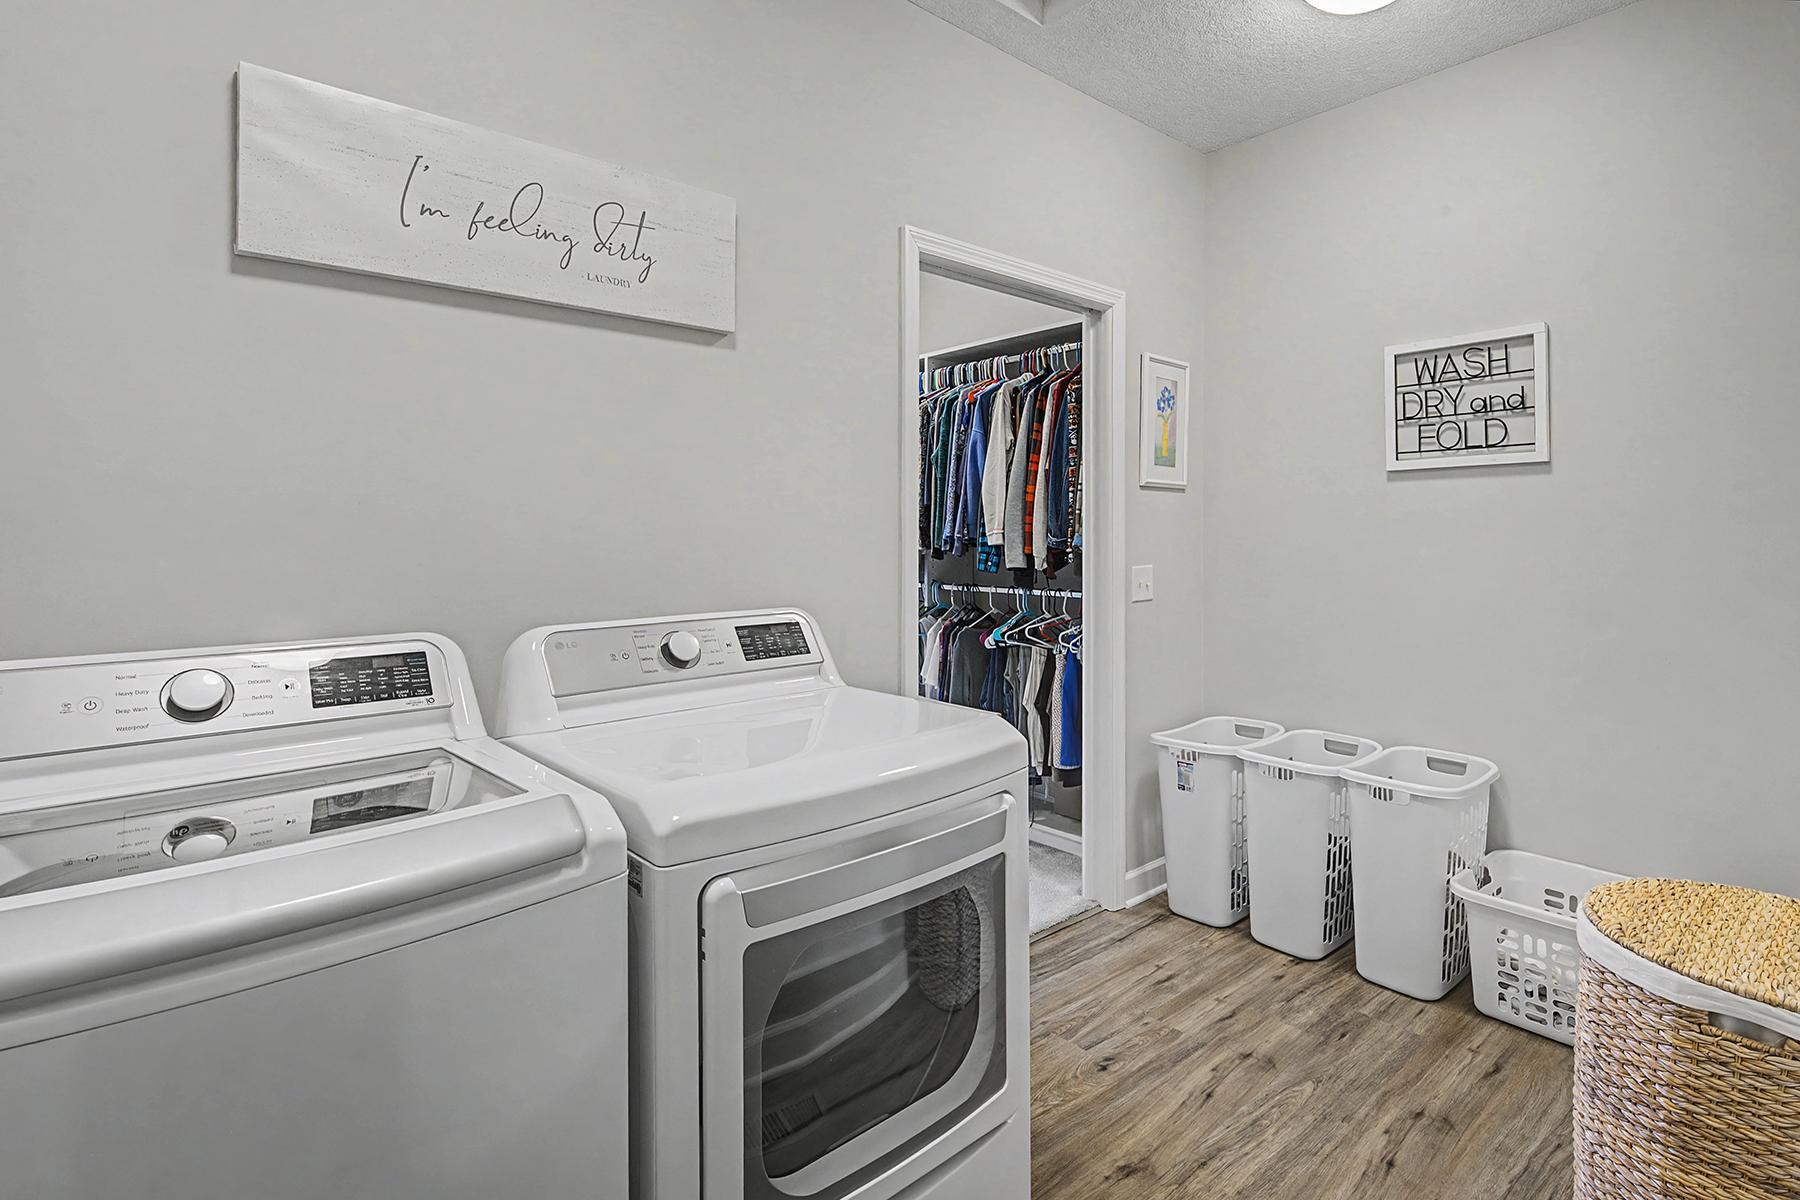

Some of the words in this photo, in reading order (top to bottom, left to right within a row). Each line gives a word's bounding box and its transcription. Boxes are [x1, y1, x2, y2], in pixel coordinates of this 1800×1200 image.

[400, 154, 451, 228] I'm
[467, 181, 580, 270] feeling
[592, 201, 657, 284] dirty
[586, 272, 633, 289] LAUNDRY
[1414, 343, 1509, 383] WASH
[1402, 384, 1464, 420] DRY
[1470, 385, 1525, 413] and
[1418, 417, 1508, 452] FOLD
[115, 723, 149, 732] Waterproof
